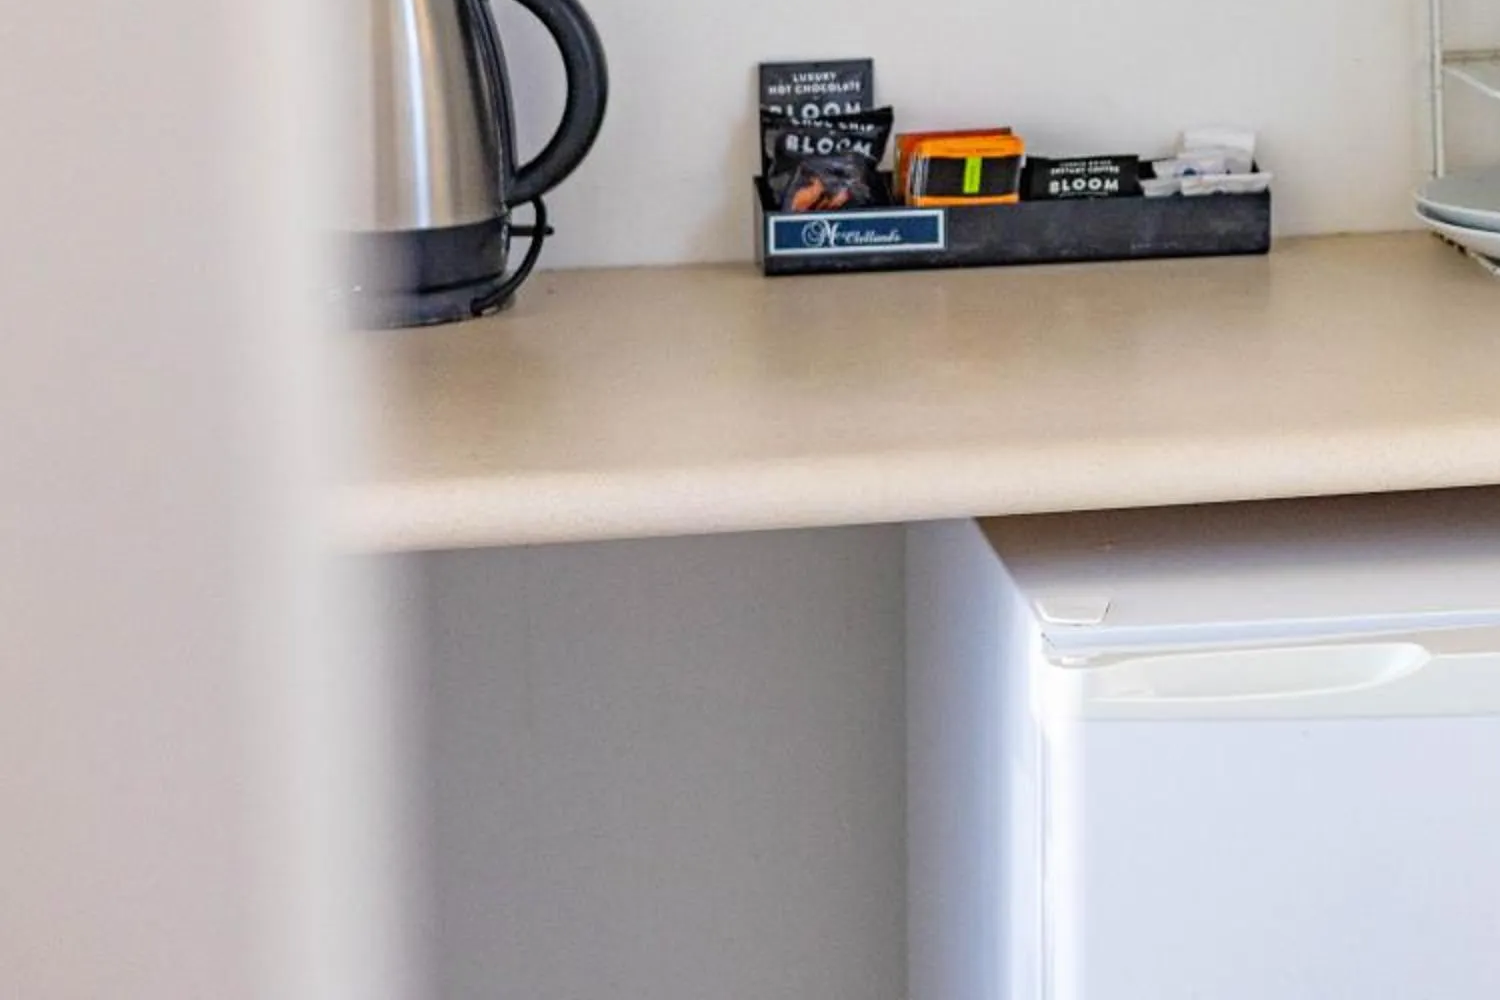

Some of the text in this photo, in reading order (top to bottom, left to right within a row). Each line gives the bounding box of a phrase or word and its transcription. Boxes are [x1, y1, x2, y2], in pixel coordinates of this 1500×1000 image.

[793, 71, 837, 83] LUXURY
[768, 80, 861, 96] HOT CHOCOLATE
[785, 133, 872, 156] BLOOM
[1049, 177, 1119, 195] BLOOM
